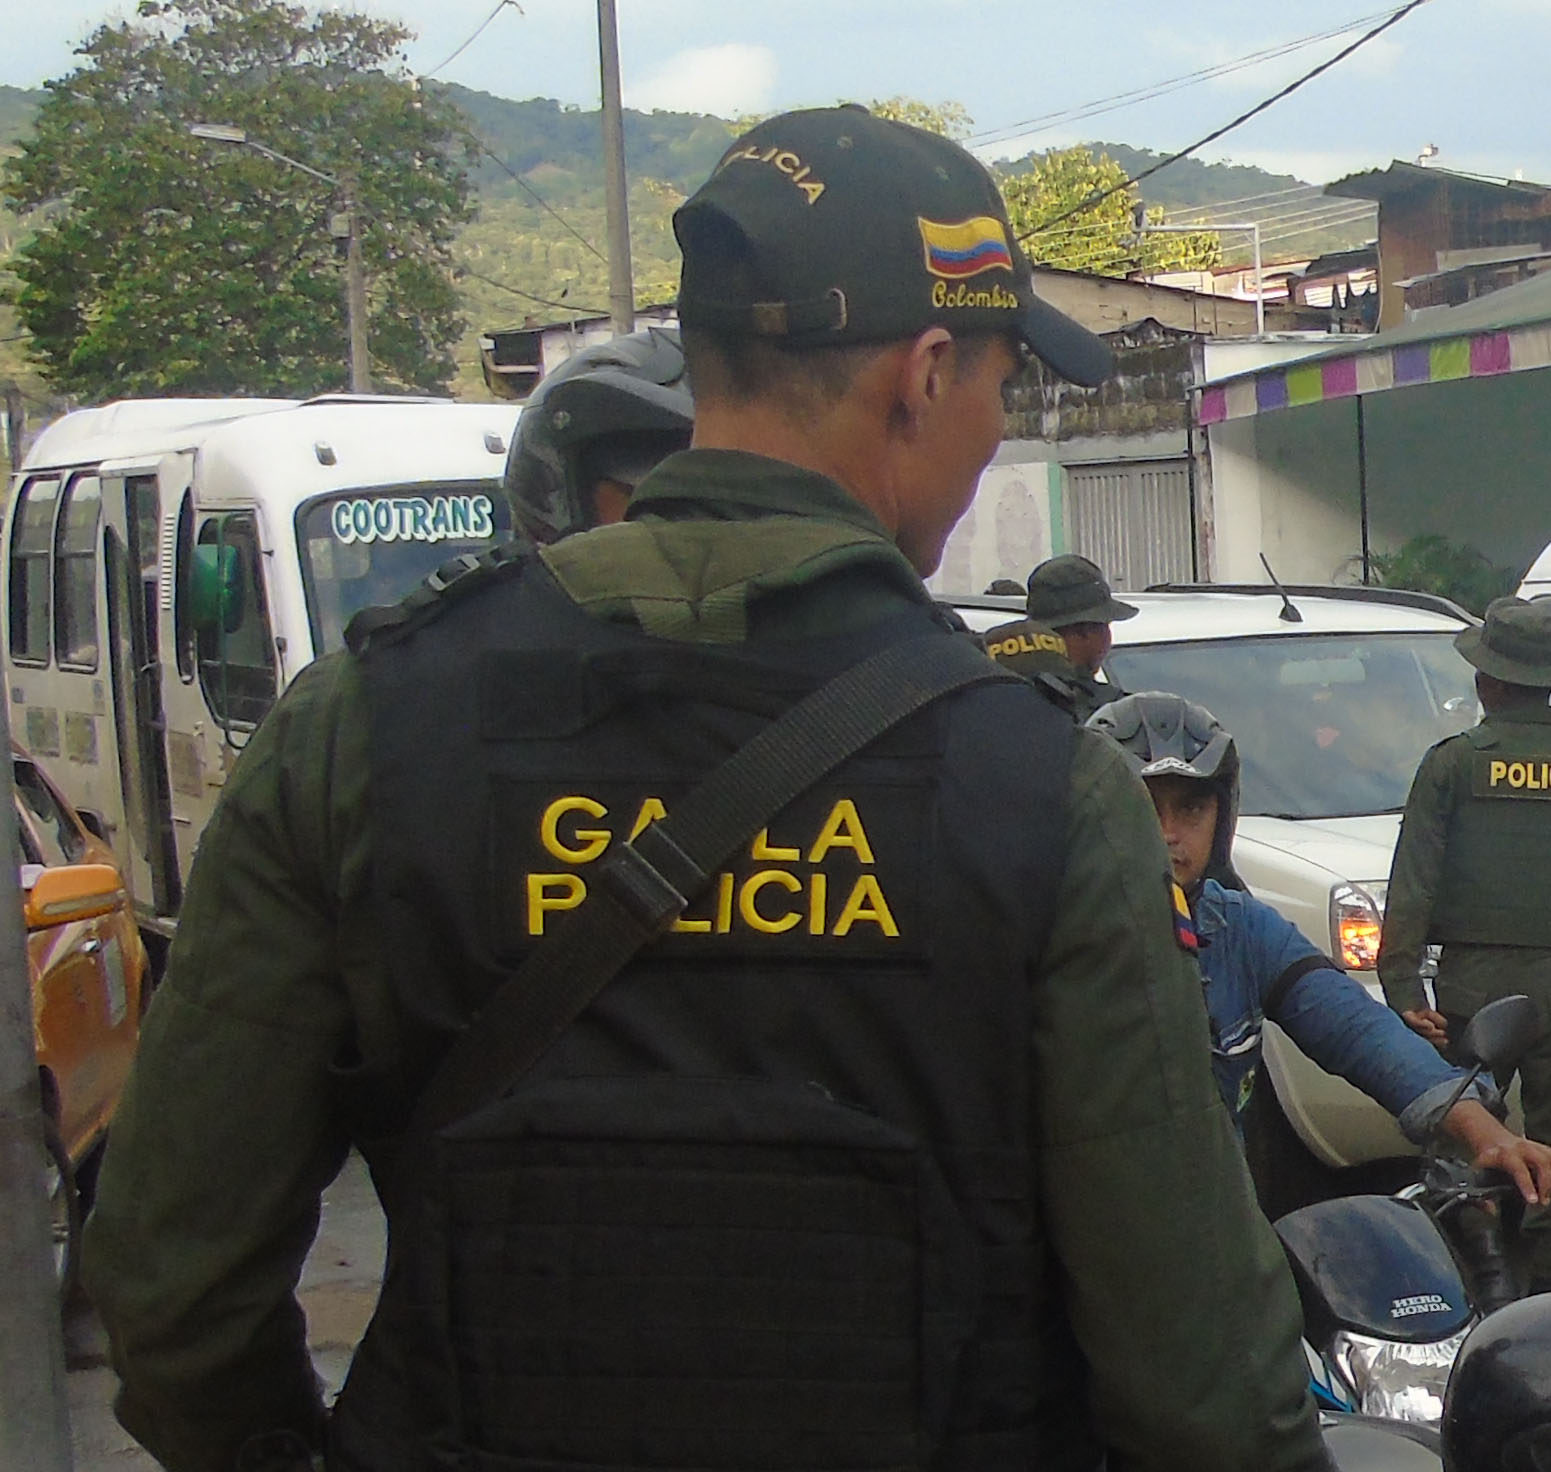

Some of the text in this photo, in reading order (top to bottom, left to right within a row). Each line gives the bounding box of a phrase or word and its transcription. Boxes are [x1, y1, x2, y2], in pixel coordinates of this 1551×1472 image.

[714, 146, 826, 205] LICIA
[931, 280, 1018, 309] Colombia
[332, 495, 493, 544] COOTRANS
[1390, 1302, 1452, 1318] HONDA
[1392, 1294, 1443, 1308] HERO
